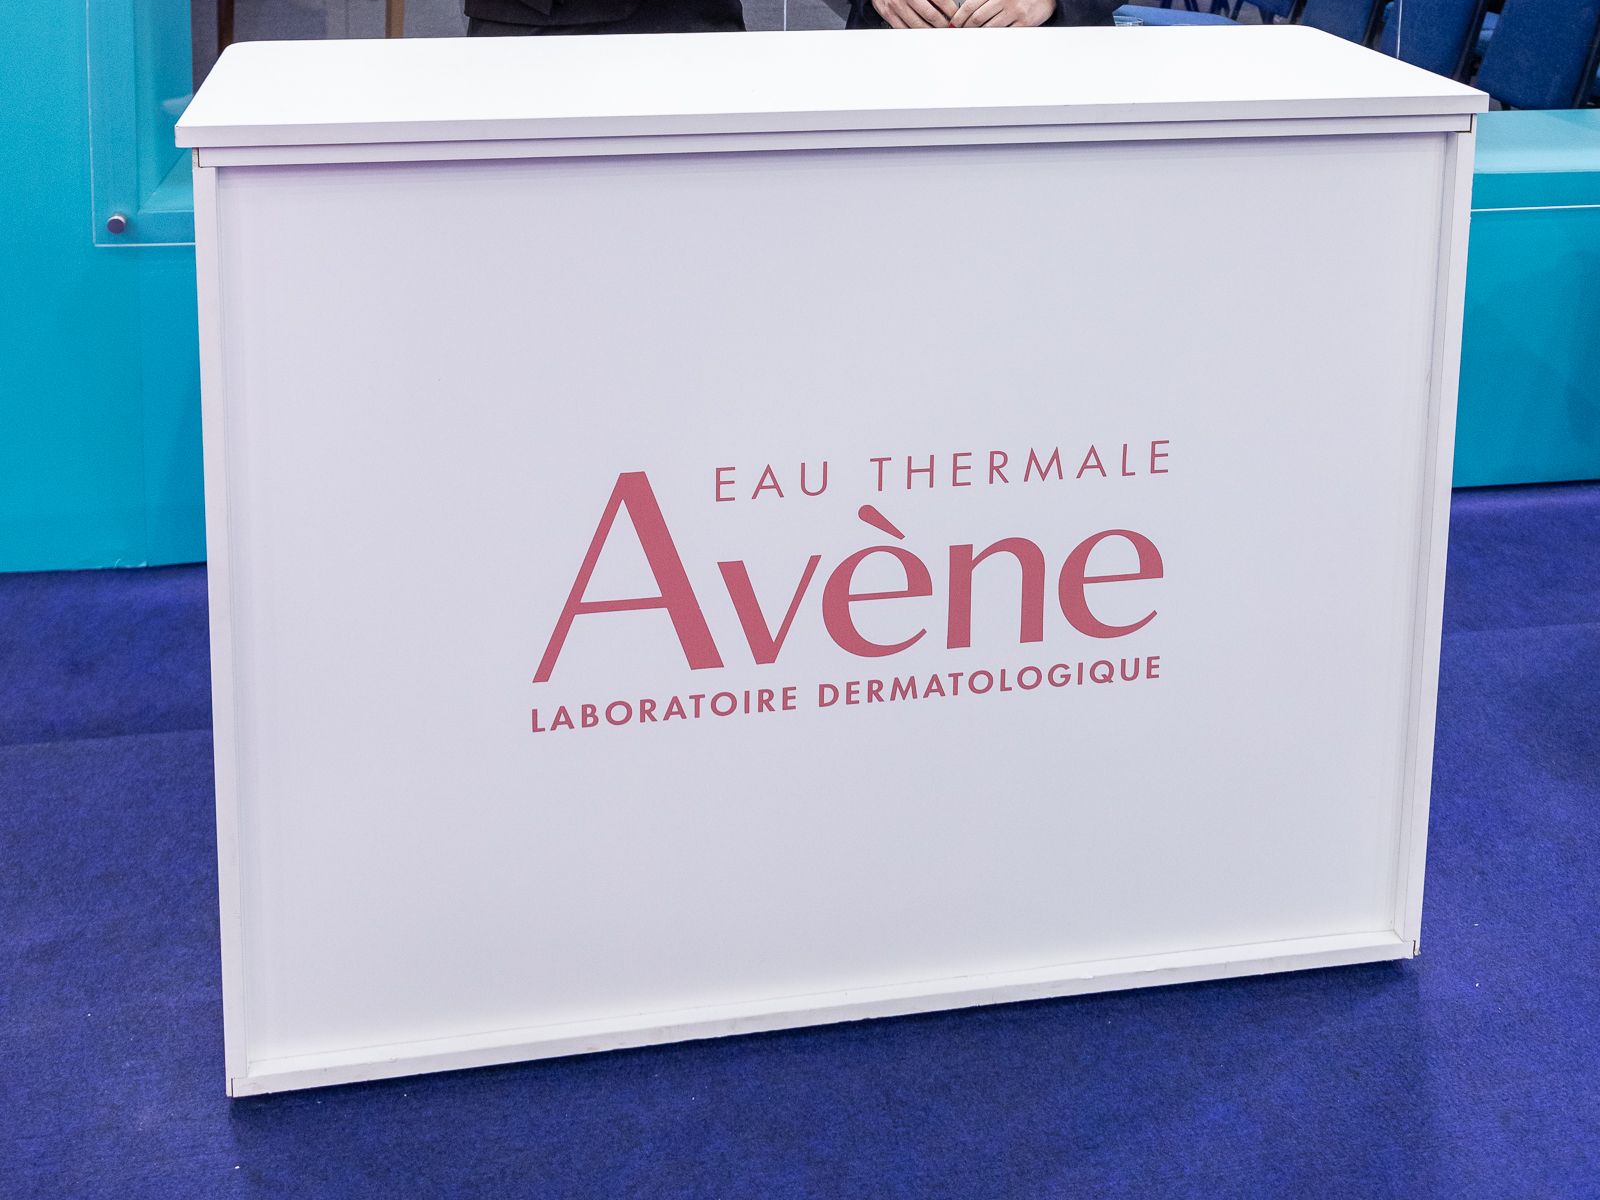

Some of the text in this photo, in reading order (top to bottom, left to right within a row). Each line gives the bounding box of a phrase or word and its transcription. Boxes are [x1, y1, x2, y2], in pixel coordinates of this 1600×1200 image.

[714, 439, 1171, 503] EAU THERMALE
[531, 470, 1165, 684] Avène
[531, 655, 1162, 734] LABORATOIRE DERMATOLOGIQUE
